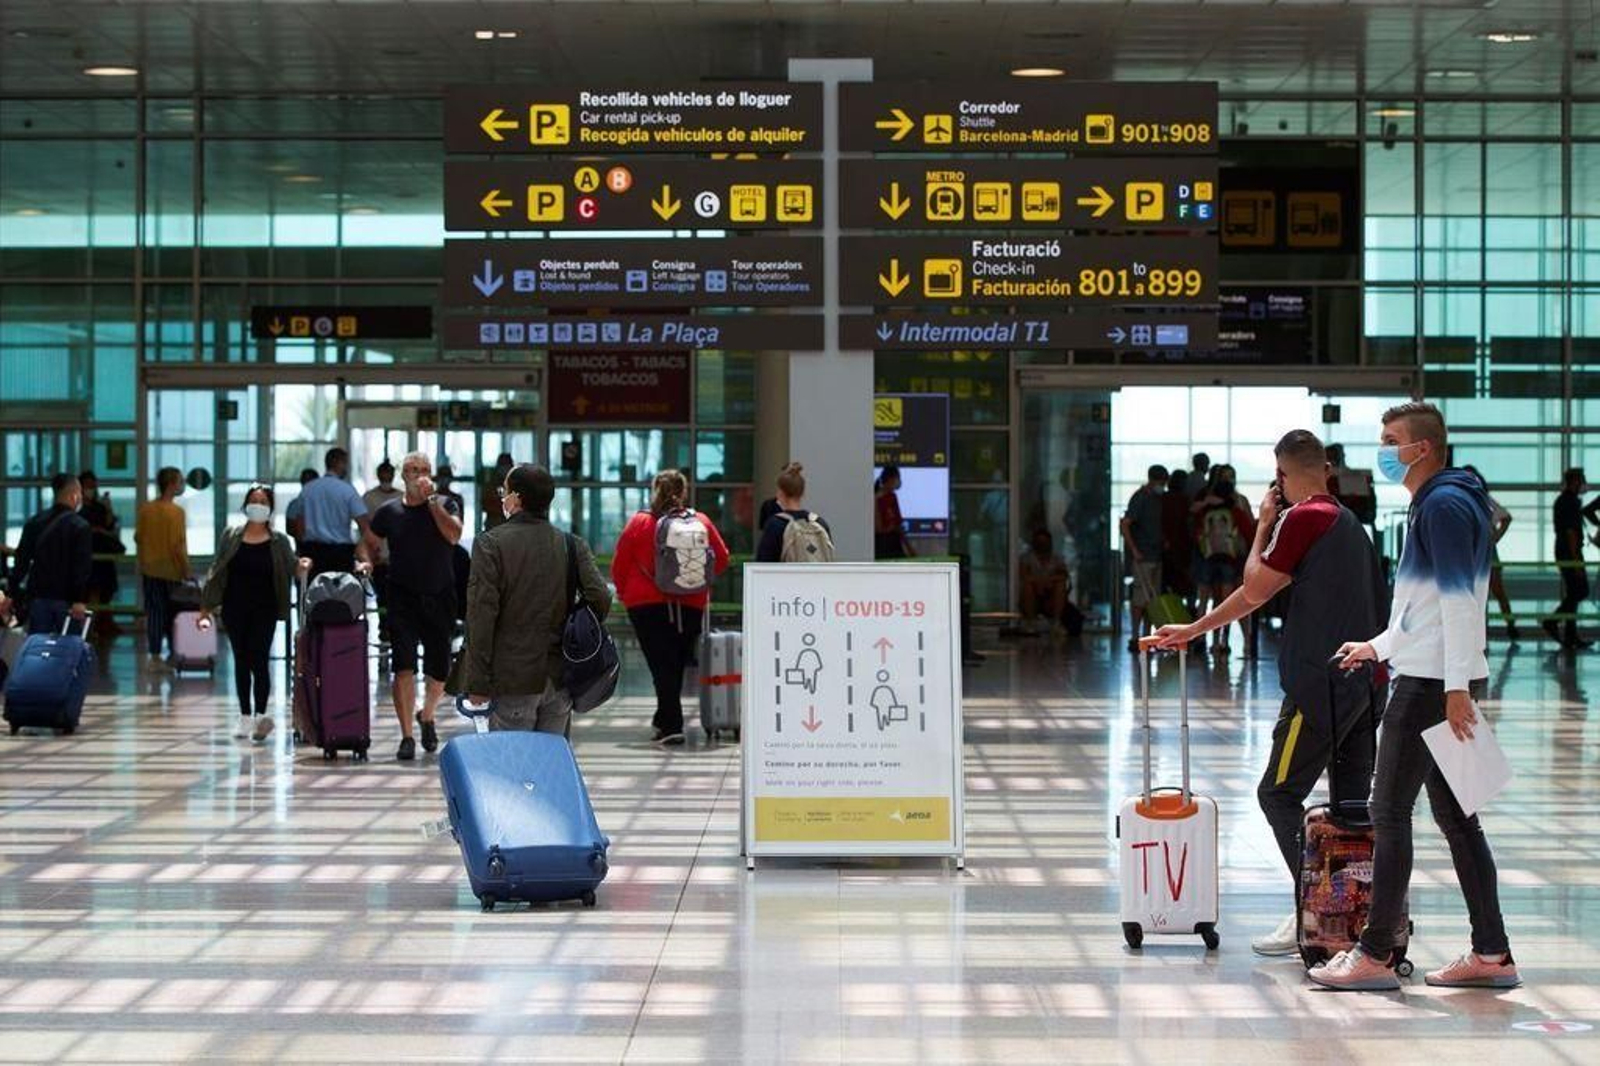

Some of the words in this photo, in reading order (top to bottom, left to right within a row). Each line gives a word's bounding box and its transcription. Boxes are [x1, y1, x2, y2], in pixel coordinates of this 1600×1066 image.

[580, 92, 648, 106] Recollida
[652, 92, 712, 106] vehicles
[717, 92, 735, 106] de
[740, 92, 791, 109] lloguer
[959, 101, 1020, 114] Corredor
[580, 112, 600, 123] Car
[605, 112, 637, 123] rental
[641, 112, 682, 126] pick-up
[959, 116, 995, 127] Shuttle
[580, 128, 649, 144] Recogida
[727, 128, 746, 142] de
[750, 128, 805, 144] alquiler
[959, 130, 1078, 143] Barcelona-Madrid
[1122, 124, 1160, 142] 901
[1170, 124, 1210, 142] 908
[580, 171, 593, 188] A
[613, 171, 625, 188] B
[926, 171, 965, 181] METRO
[733, 188, 763, 197] HOTEL
[1179, 185, 1190, 198] D
[580, 200, 593, 217] C
[699, 194, 715, 213] G
[1179, 204, 1188, 217] F
[1199, 204, 1208, 217] E
[972, 240, 1061, 256] Facturació
[540, 260, 581, 271] Objectes
[584, 260, 619, 271] perduts
[652, 260, 695, 271] Consigna
[731, 260, 752, 270] Tour
[755, 260, 802, 272] operadors
[972, 261, 1035, 275] Check-in
[1134, 262, 1147, 276] to
[540, 272, 557, 280] Lost
[560, 272, 566, 280] &
[568, 272, 592, 280] found
[652, 272, 667, 280] Left
[670, 272, 700, 282] luggage
[732, 272, 749, 280] Tour
[752, 272, 789, 282] operators
[540, 282, 576, 292] Objetos
[578, 282, 619, 292] perdidos
[652, 282, 695, 292] Consigna
[732, 282, 752, 291] Tour
[756, 282, 809, 293] Operadores
[972, 279, 1071, 296] Facturación
[1079, 270, 1130, 296] 801
[1148, 270, 1201, 296] 899
[1135, 284, 1144, 296] a
[627, 323, 653, 342] La
[661, 322, 719, 347] Plaça
[900, 321, 1017, 342] Intermodal
[1025, 322, 1050, 342] T1
[553, 356, 619, 368] TABACOS
[632, 356, 687, 368] TABACS
[581, 373, 659, 386] TOBACCOS
[771, 597, 815, 617] info
[834, 600, 925, 617] COVID-19
[905, 812, 931, 820] aena
[1131, 840, 1187, 902] TV
